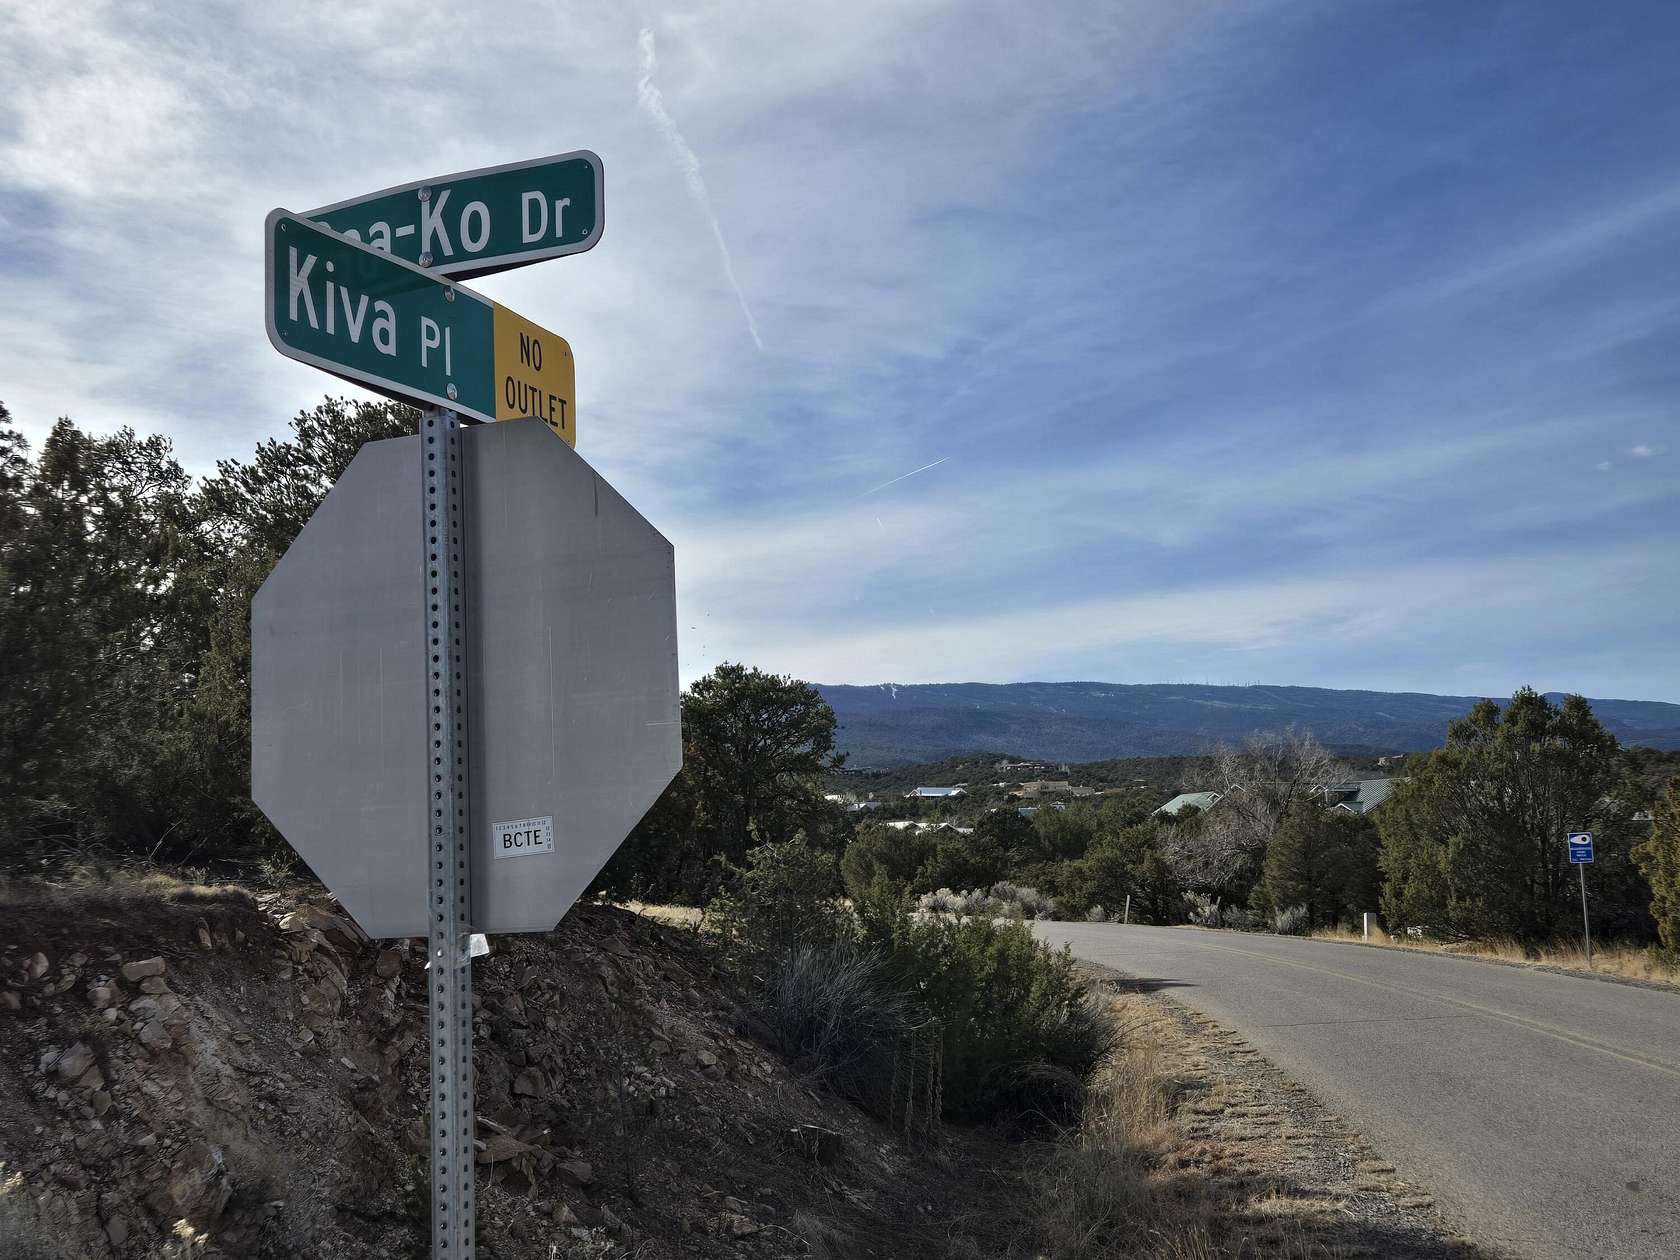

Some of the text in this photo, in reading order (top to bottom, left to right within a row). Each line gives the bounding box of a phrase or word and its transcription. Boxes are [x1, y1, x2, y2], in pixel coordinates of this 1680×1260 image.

[315, 189, 570, 257] a-Ko Dr
[288, 246, 451, 377] Kiva Pl
[520, 332, 542, 371] NO
[505, 375, 567, 430] OUTLET
[503, 829, 543, 849] BCTE
